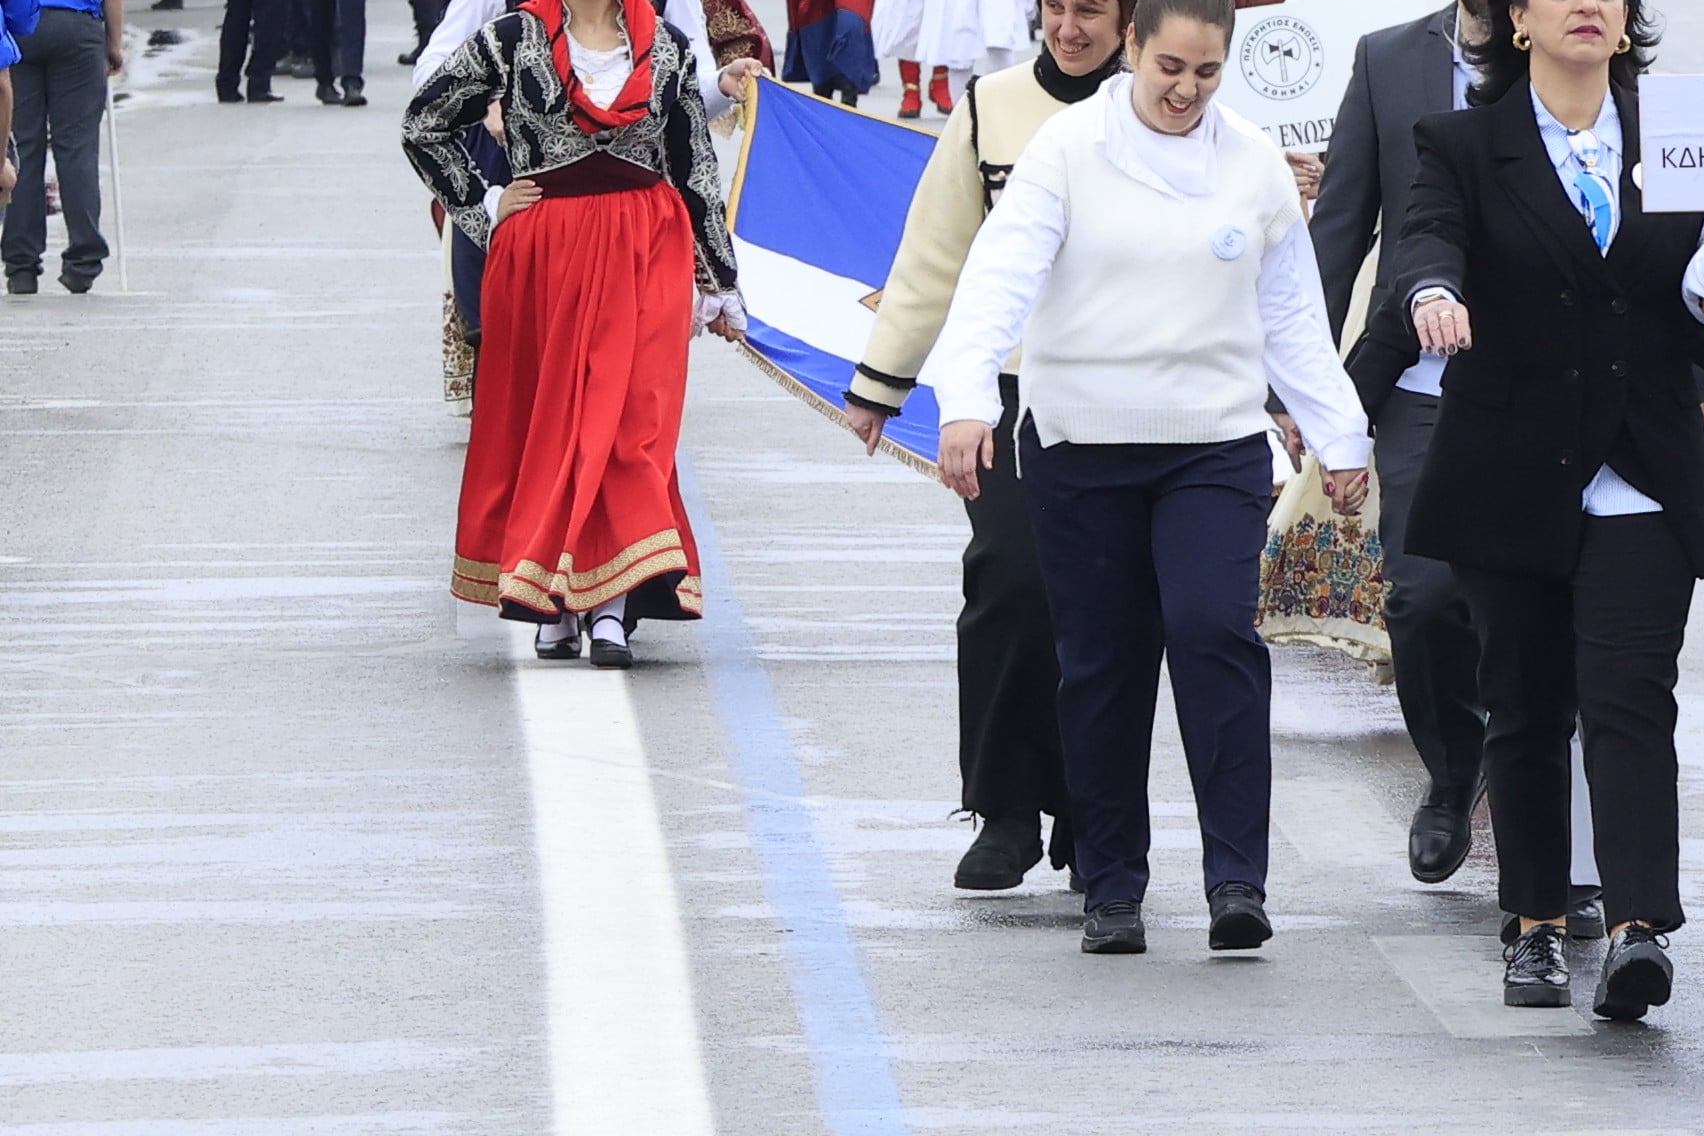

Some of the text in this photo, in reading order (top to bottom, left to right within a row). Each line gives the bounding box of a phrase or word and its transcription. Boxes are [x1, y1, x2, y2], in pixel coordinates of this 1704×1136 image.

[1243, 19, 1321, 62] ΠΑΓΚΡΗΤΙΟΣ ΕΝΩΣΙΣ
[1262, 80, 1310, 97] ΑΘΗΝΑΙ
